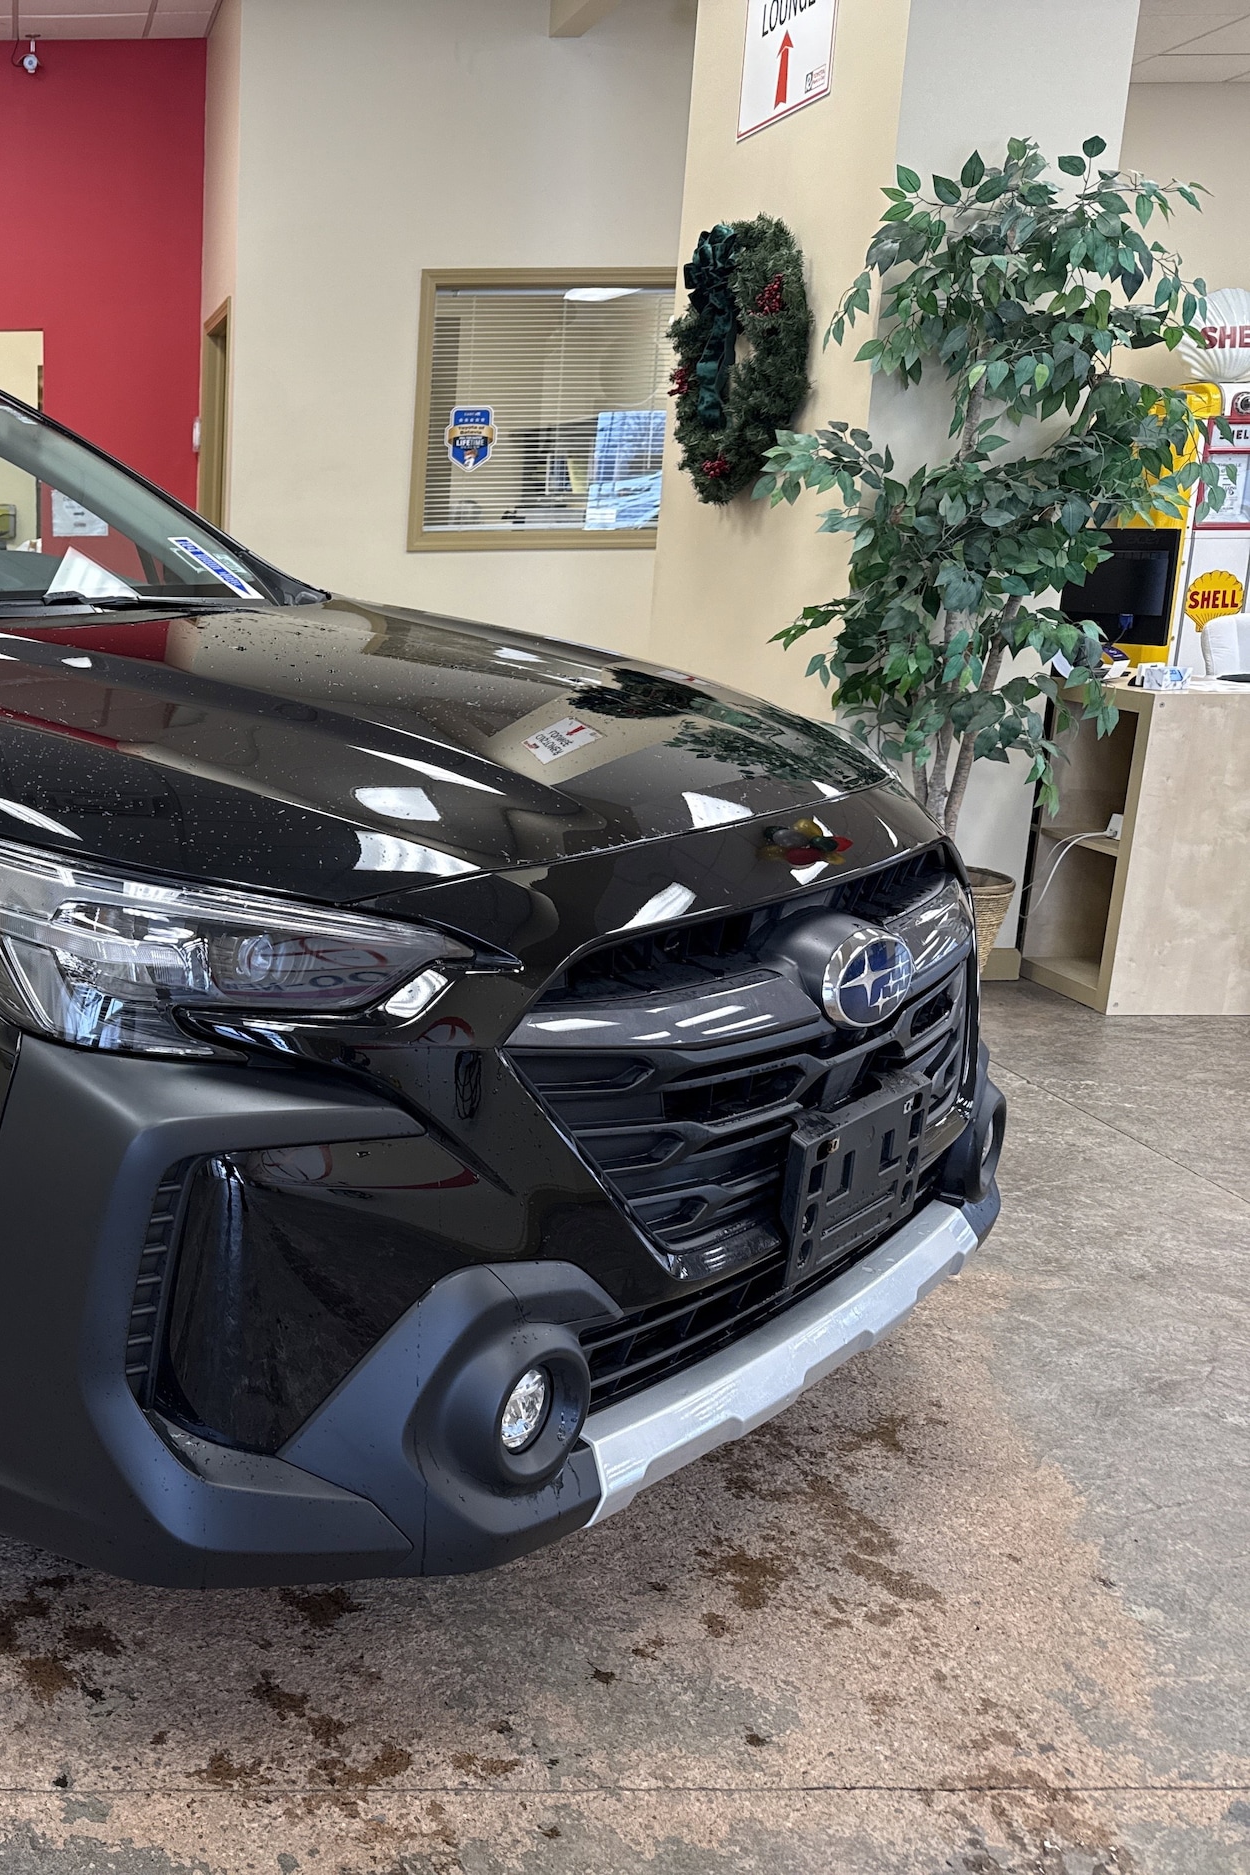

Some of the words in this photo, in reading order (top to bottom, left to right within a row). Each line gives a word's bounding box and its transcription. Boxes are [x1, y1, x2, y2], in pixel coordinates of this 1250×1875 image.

[761, 0, 817, 38] LOUN
[455, 439, 485, 447] LIFETIME
[1188, 589, 1239, 609] SHELL
